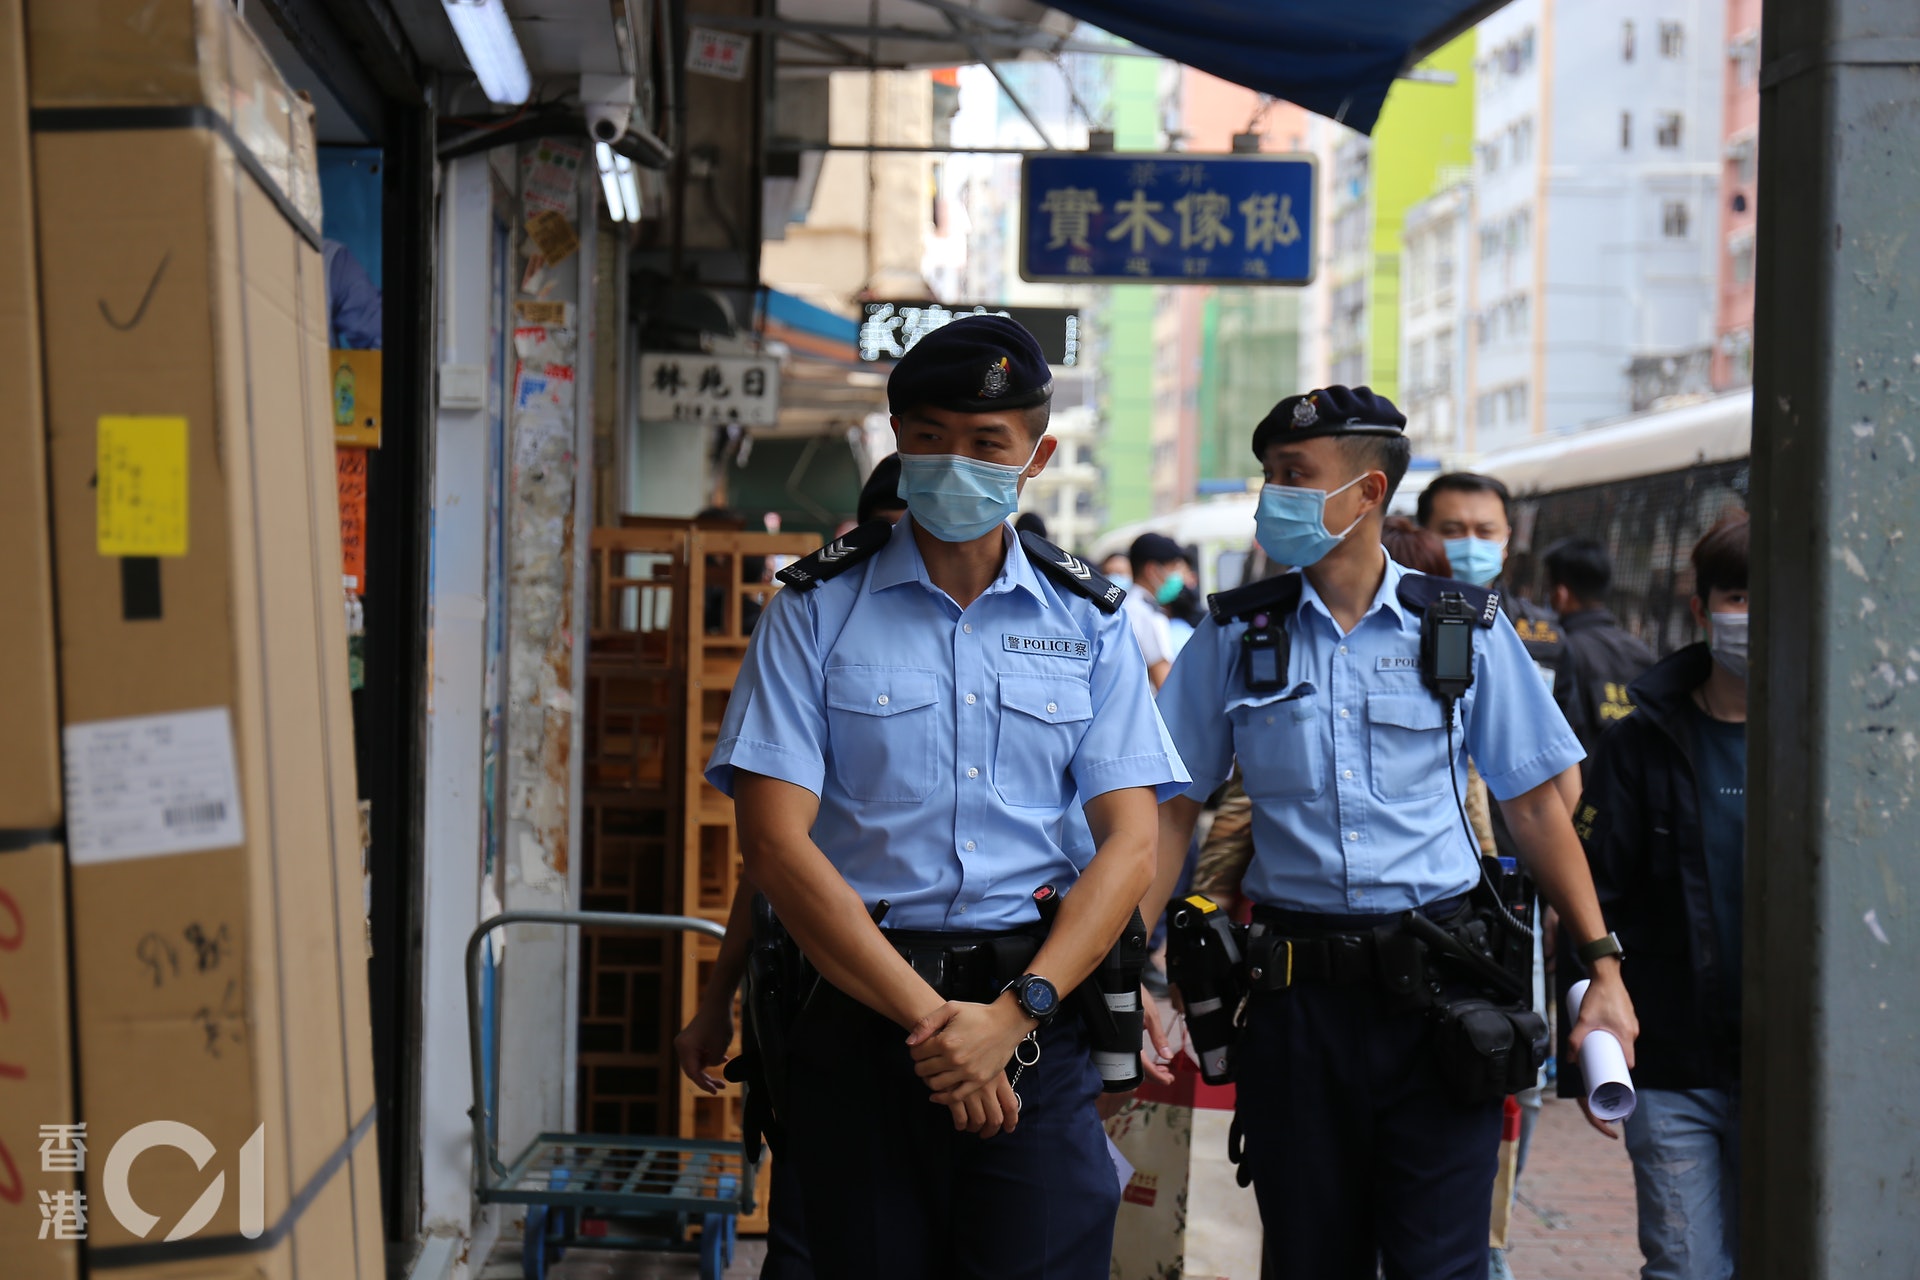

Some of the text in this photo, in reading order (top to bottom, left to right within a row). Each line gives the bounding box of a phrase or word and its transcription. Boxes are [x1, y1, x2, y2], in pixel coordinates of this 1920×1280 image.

[1104, 585, 1121, 603] 21296
[1483, 594, 1498, 620] 22132
[1008, 637, 1087, 656] 警 POLICE 察
[1394, 658, 1420, 668] POL
